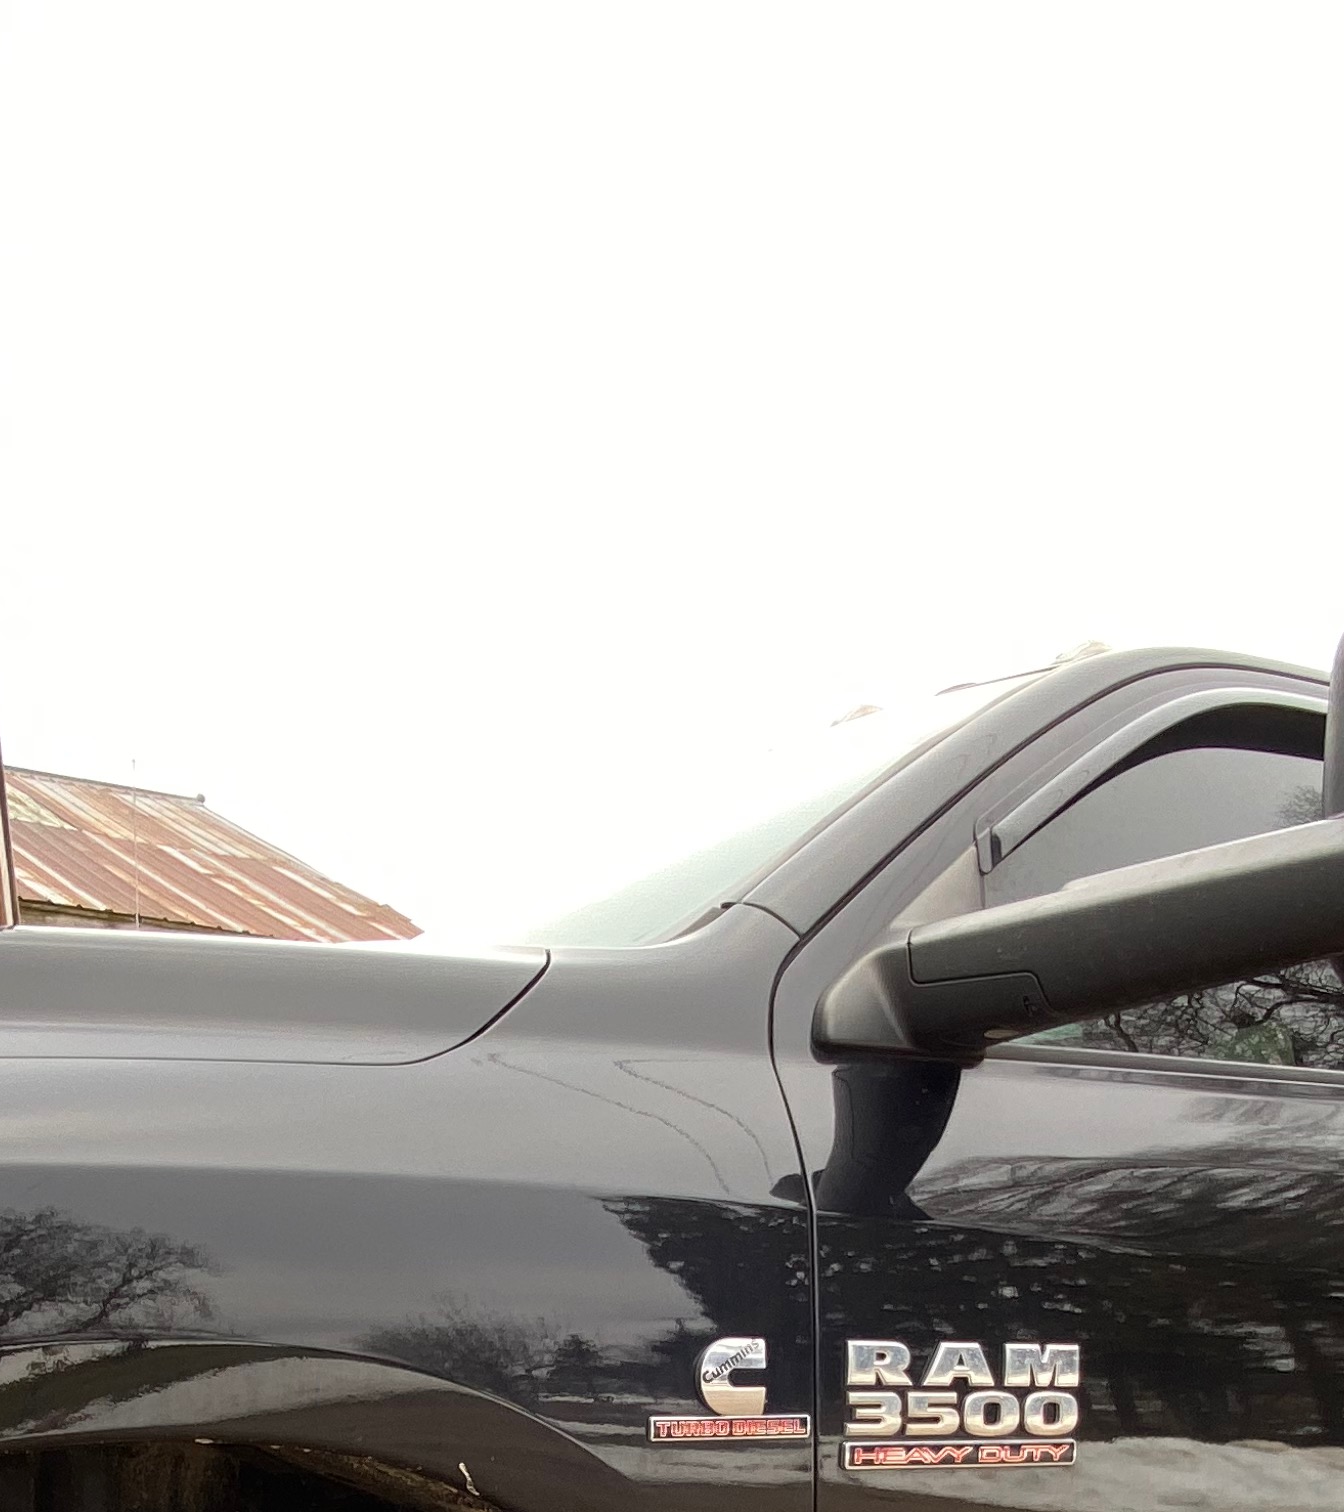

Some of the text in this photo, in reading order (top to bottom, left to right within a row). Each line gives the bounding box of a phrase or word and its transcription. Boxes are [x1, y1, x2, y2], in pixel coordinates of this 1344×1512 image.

[702, 1339, 760, 1383] Cummins
[846, 1340, 1079, 1387] RAM
[656, 1419, 806, 1437] TURBO DIESEL
[844, 1391, 1078, 1436] 3500
[854, 1445, 1069, 1464] HEAVY DUTY
